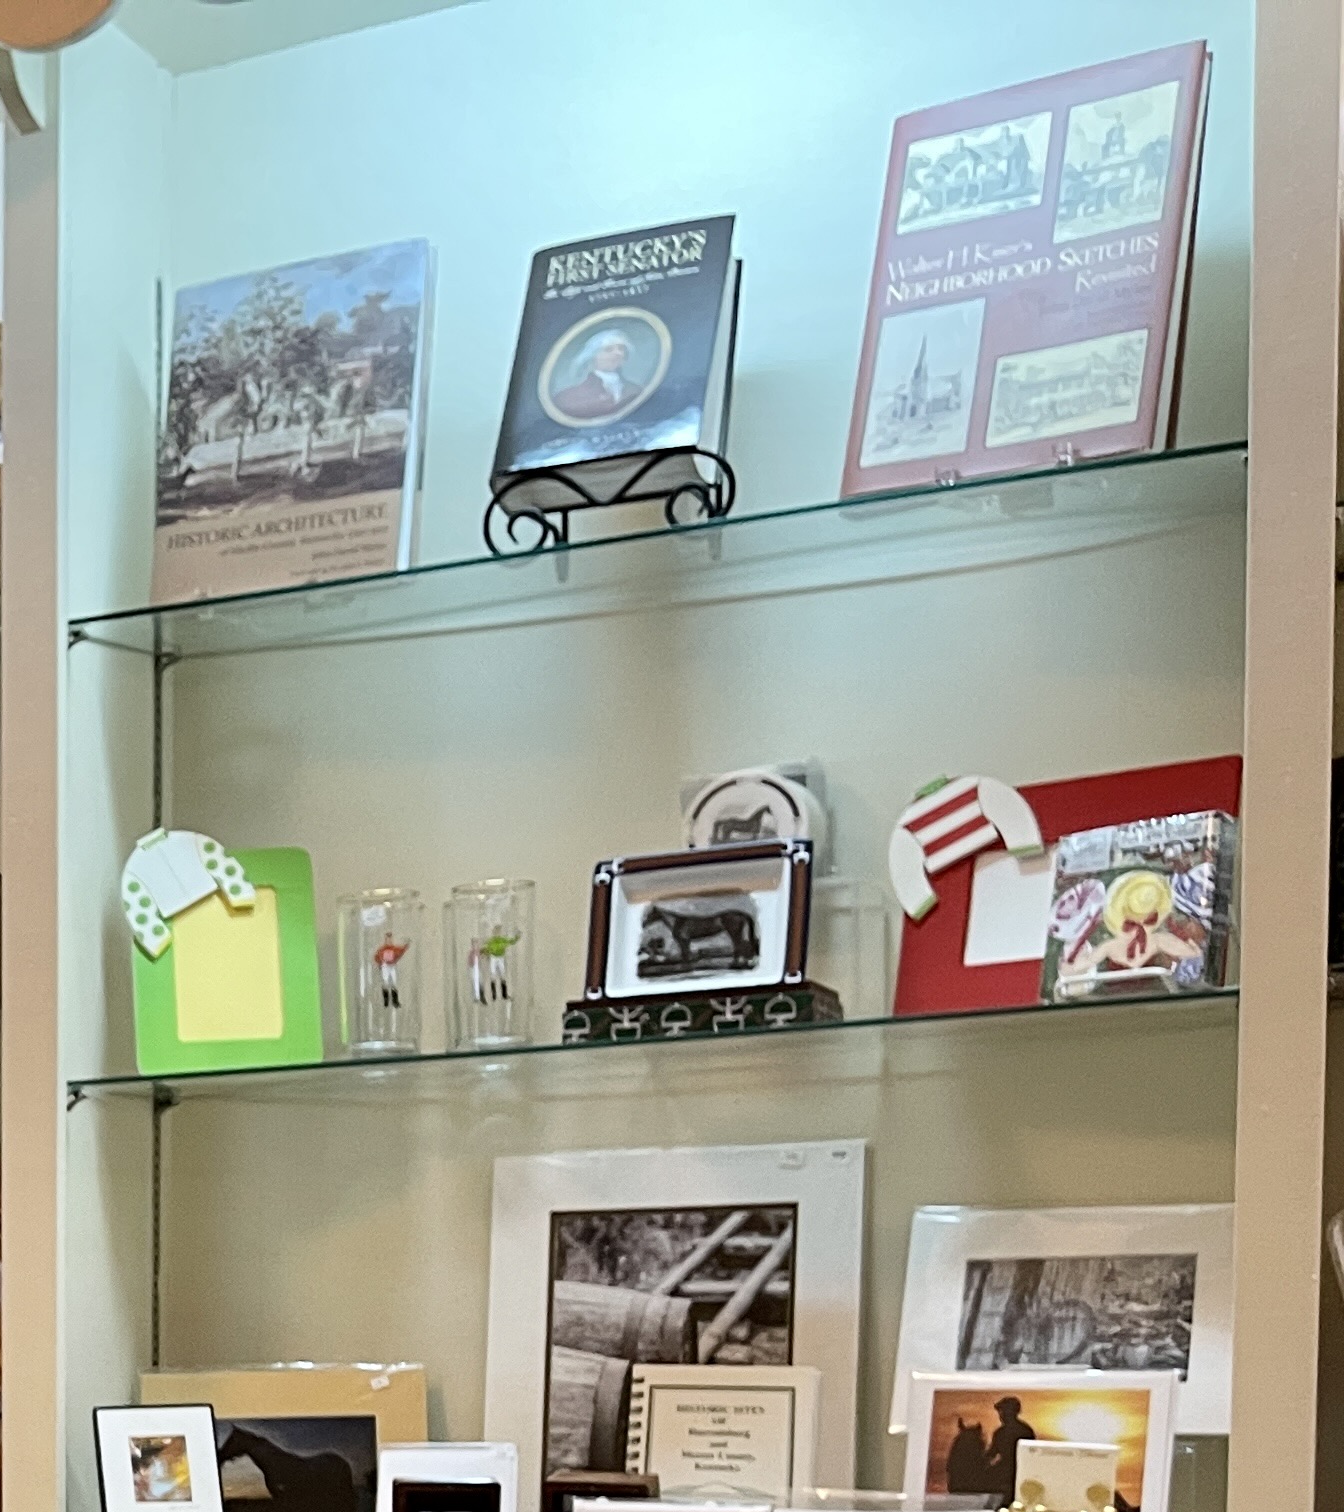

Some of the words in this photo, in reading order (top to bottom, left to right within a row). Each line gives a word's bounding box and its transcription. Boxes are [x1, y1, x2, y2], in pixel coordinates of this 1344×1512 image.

[885, 256, 1053, 307] NEIGHBORHOOD
[166, 523, 249, 550] HISTORIC
[252, 502, 388, 538] ARCHITECTURE
